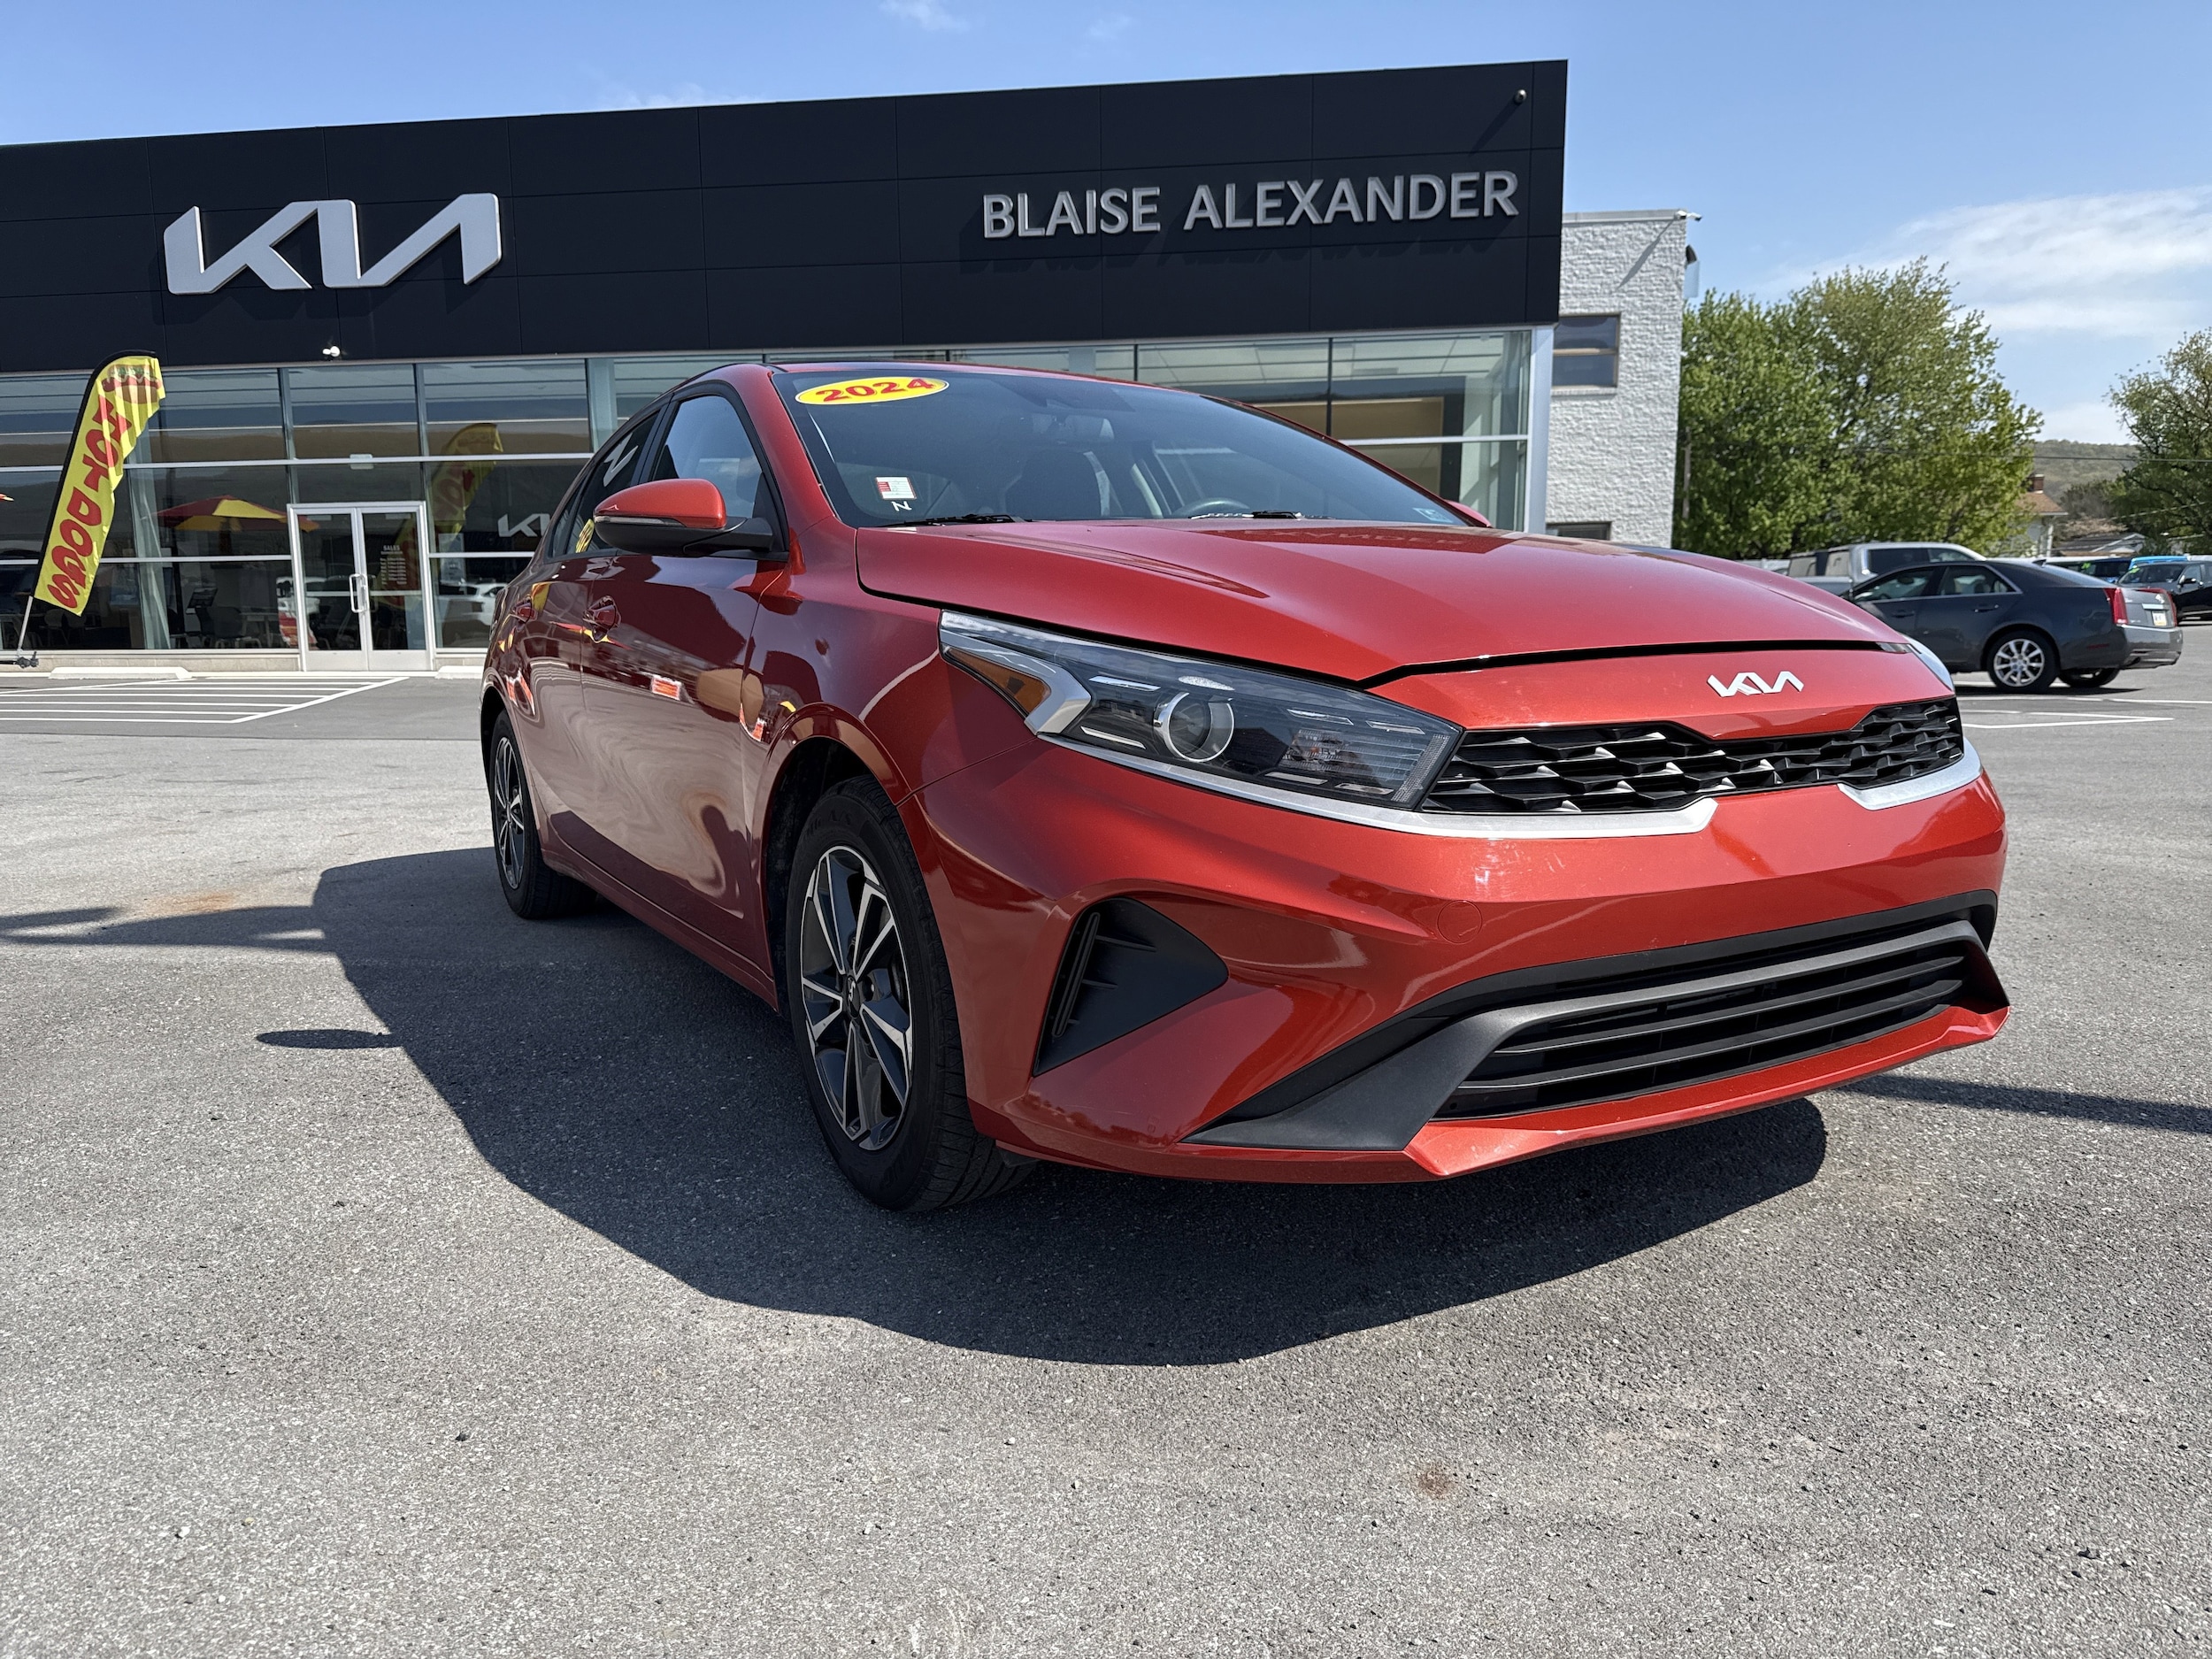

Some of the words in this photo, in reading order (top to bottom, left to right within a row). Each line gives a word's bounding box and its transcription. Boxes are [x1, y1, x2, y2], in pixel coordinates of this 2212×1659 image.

[983, 187, 1161, 238] BLAISE
[1183, 171, 1519, 230] ALEXANDER
[164, 192, 503, 295] KIA
[816, 378, 935, 403] 2024
[82, 395, 133, 493] HOT
[48, 487, 103, 609] DOGS
[497, 513, 551, 537] KI
[1707, 671, 1805, 698] KIA
